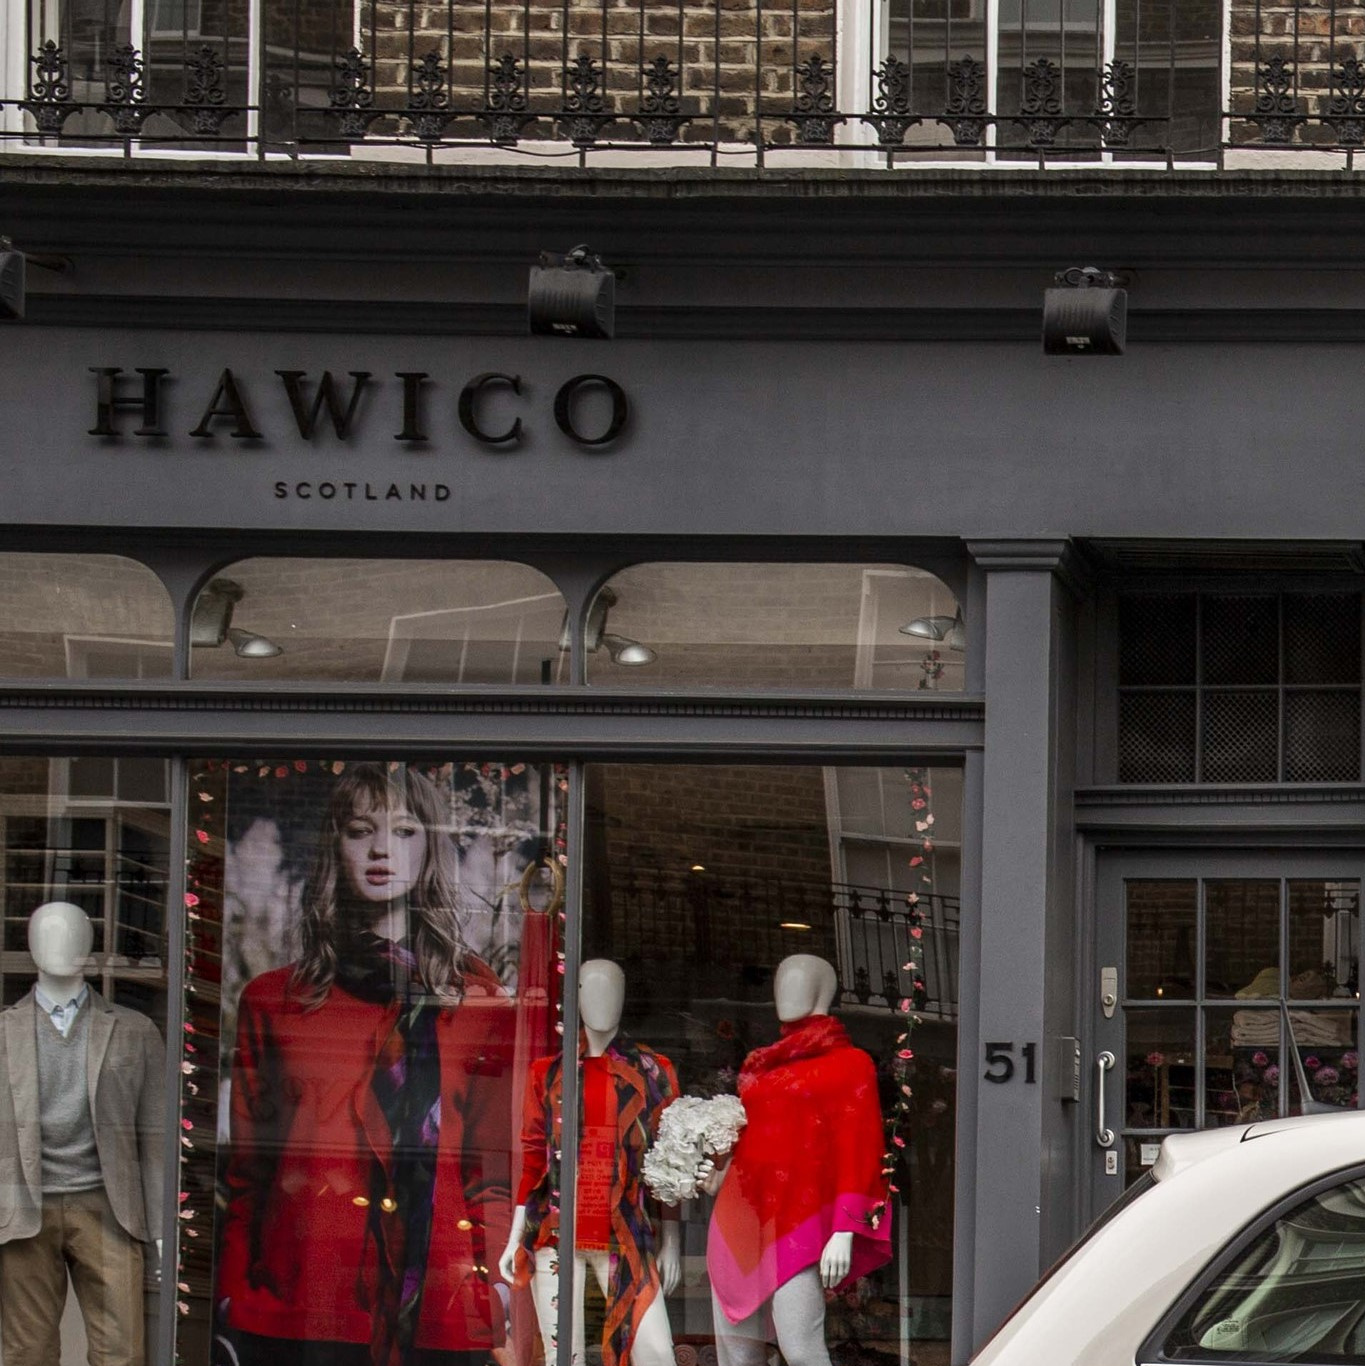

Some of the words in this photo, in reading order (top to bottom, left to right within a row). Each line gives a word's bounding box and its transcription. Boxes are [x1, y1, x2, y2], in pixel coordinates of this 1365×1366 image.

[88, 366, 630, 445] HAWICO
[274, 481, 452, 501] SCOTLAND
[984, 1042, 1037, 1084] 51
